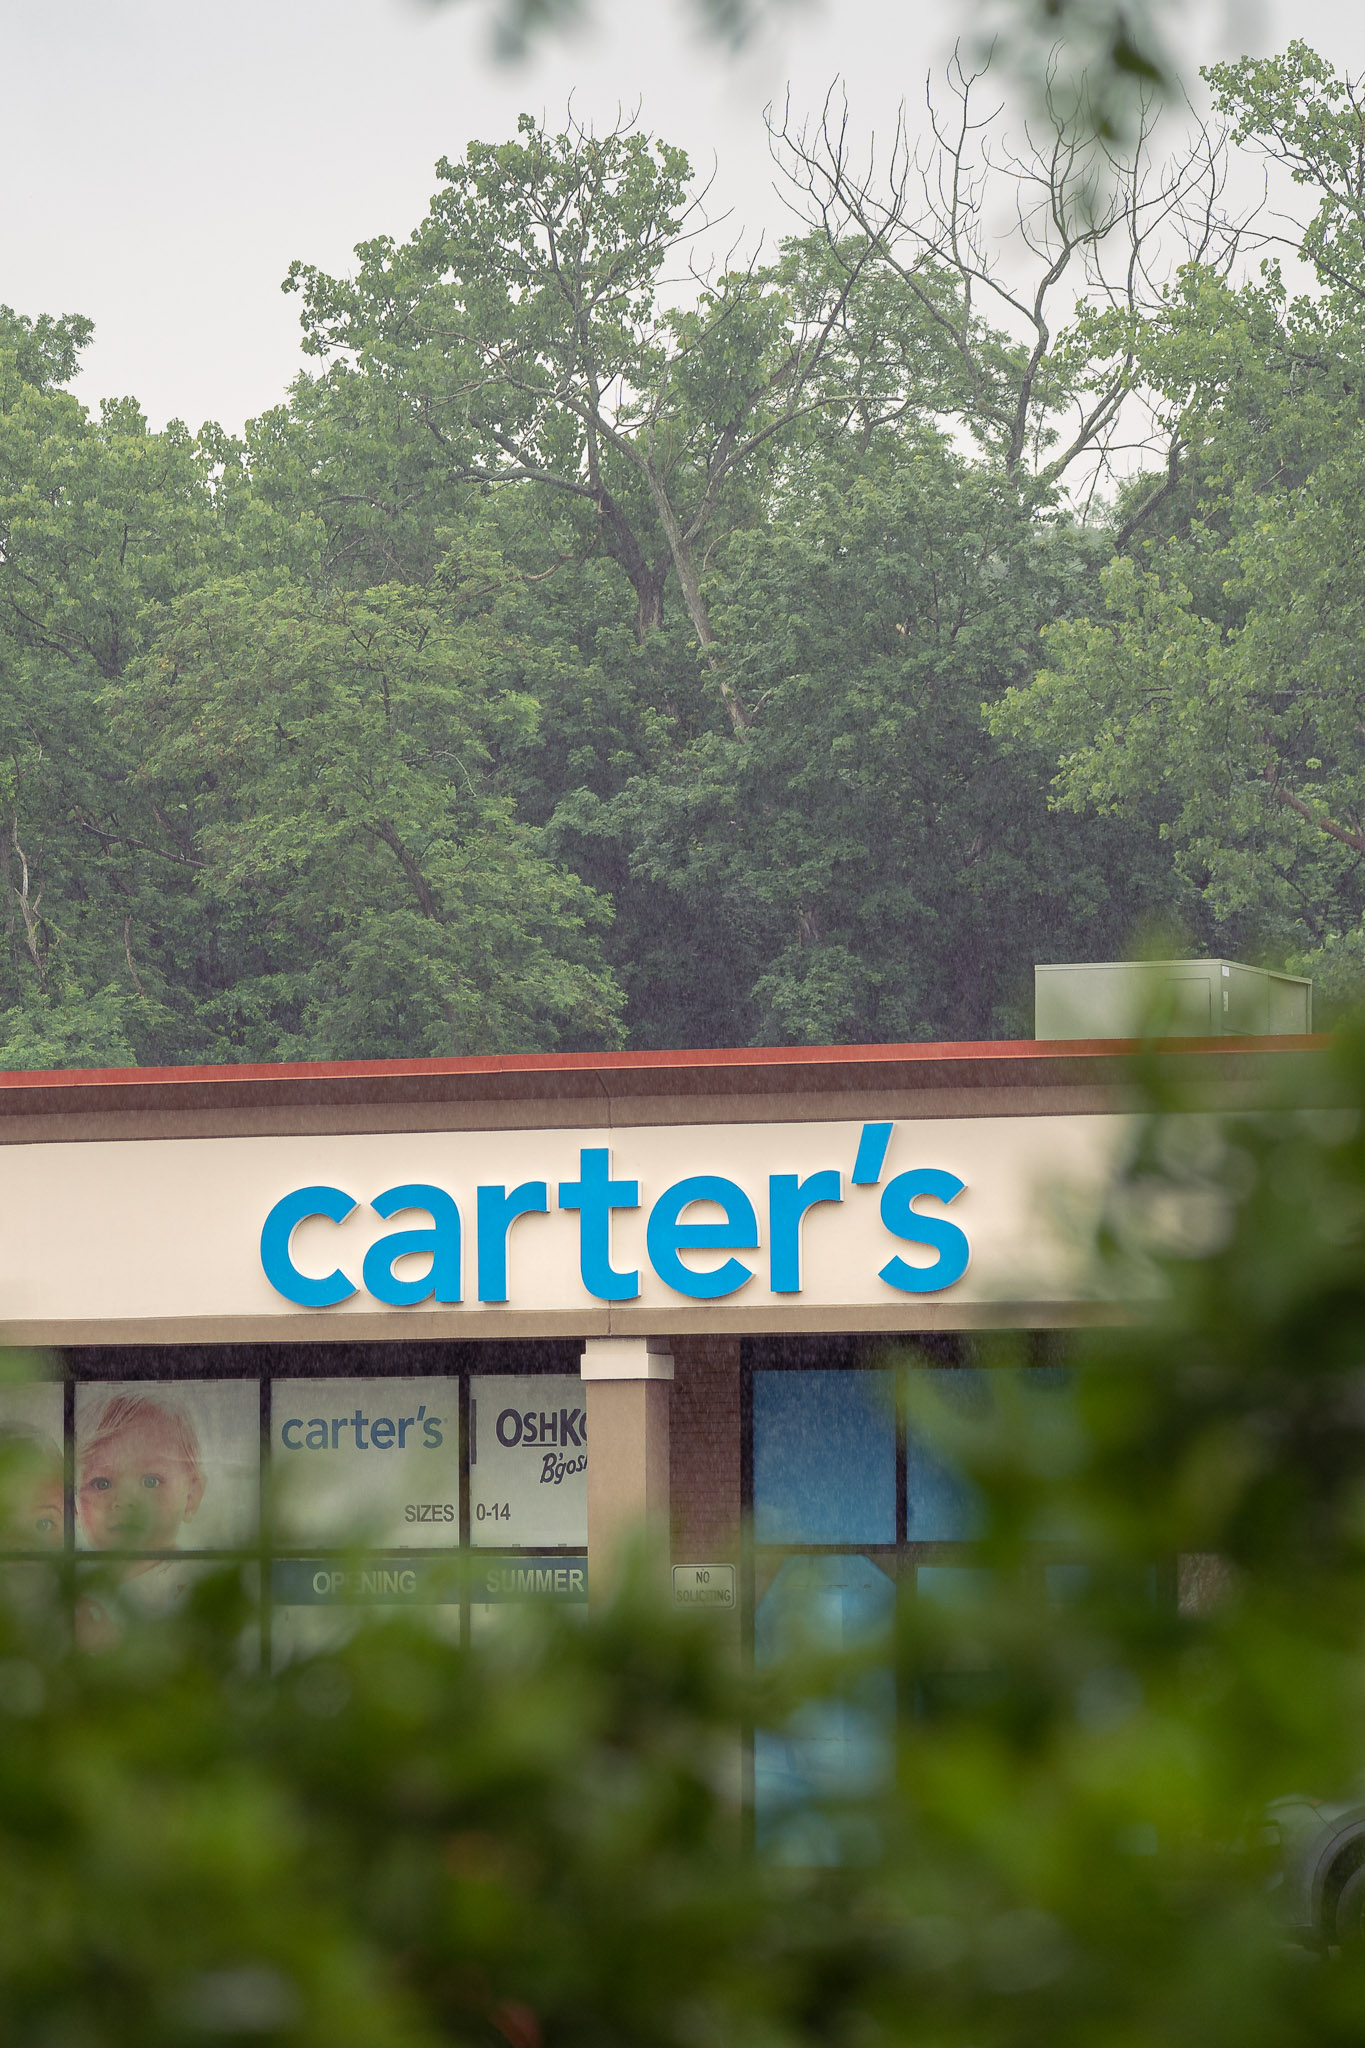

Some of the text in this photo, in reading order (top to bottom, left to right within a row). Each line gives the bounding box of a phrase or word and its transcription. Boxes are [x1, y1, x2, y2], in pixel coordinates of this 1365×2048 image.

[260, 1122, 971, 1307] carter's
[281, 1405, 444, 1450] carter's
[404, 1503, 511, 1523] SIZES 0-14
[486, 1569, 585, 1593] SUMMER
[696, 1571, 710, 1584] NO
